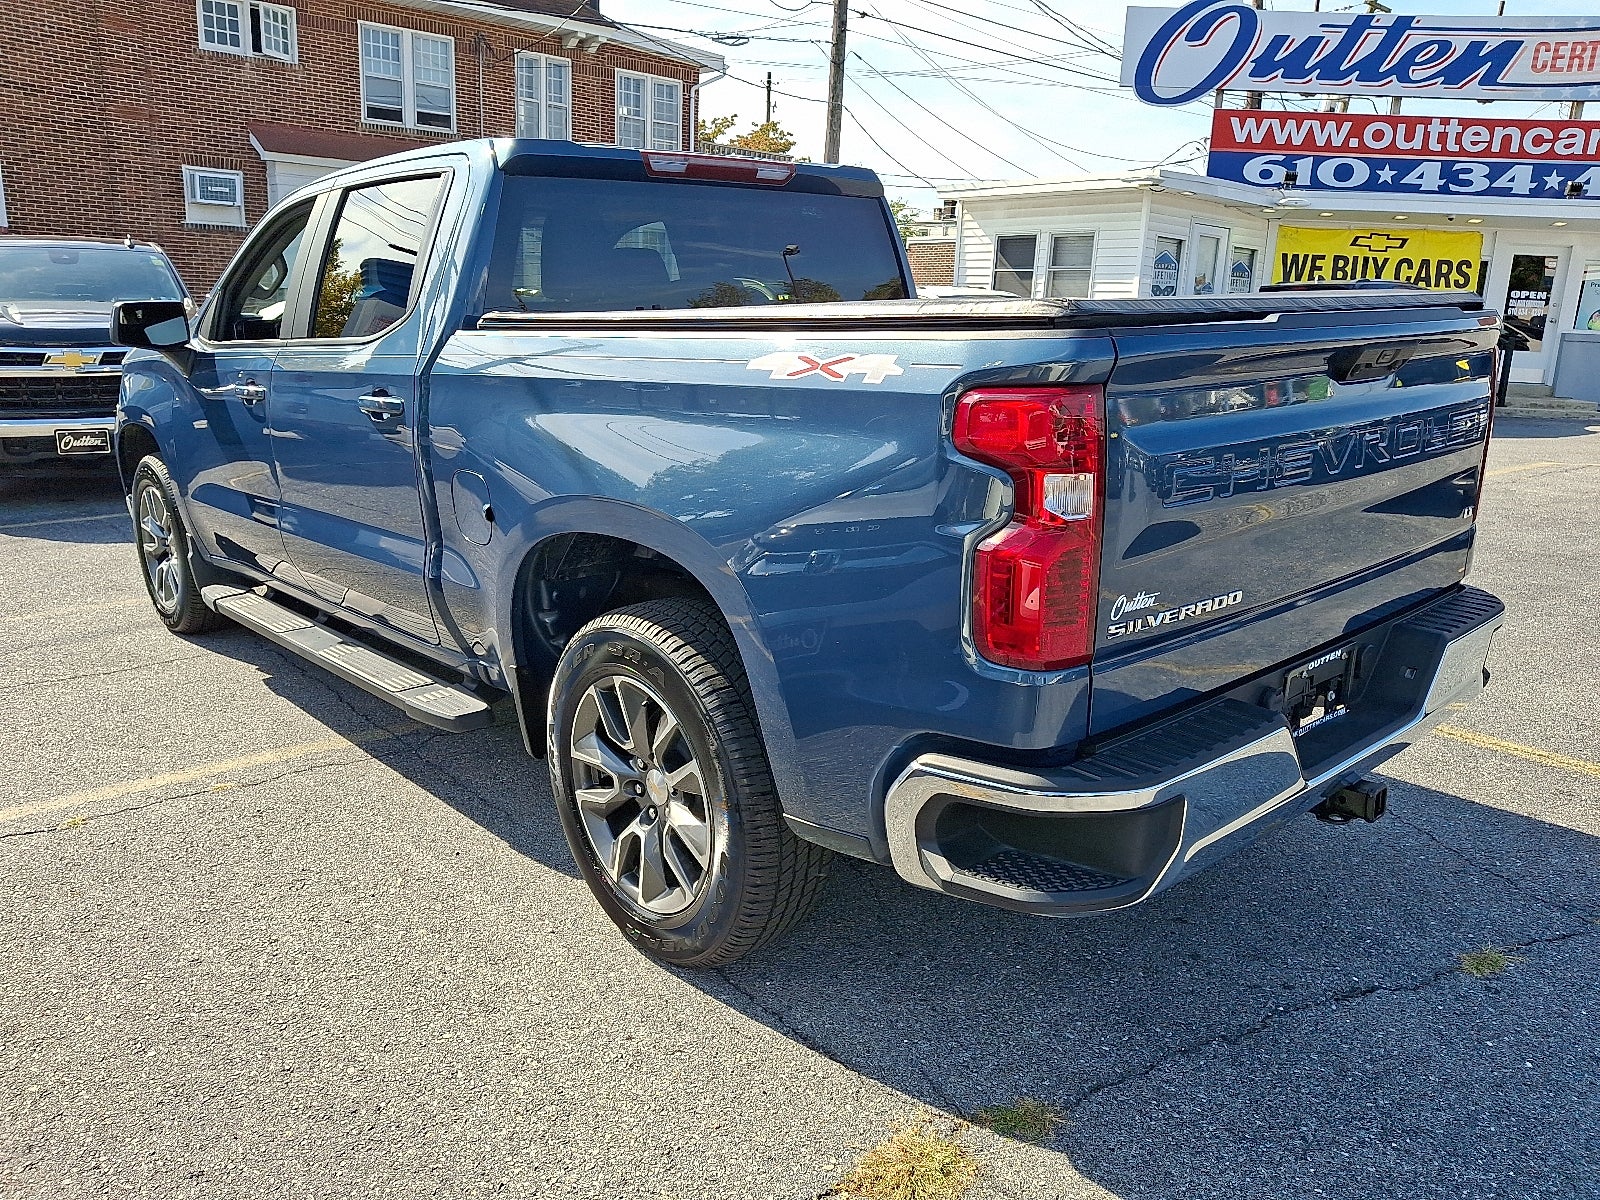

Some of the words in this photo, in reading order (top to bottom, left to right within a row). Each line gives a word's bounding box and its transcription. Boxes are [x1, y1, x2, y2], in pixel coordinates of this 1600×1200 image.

[1134, 0, 1525, 107] Outten
[1281, 253, 1326, 283] WE
[1331, 255, 1390, 282] BUY
[1393, 257, 1472, 289] CARS
[1511, 291, 1547, 299] OPEN
[61, 435, 107, 450] Outten
[1106, 590, 1243, 639] SILVERADO
[1110, 591, 1161, 621] Outten
[1308, 649, 1342, 670] OUTTEN
